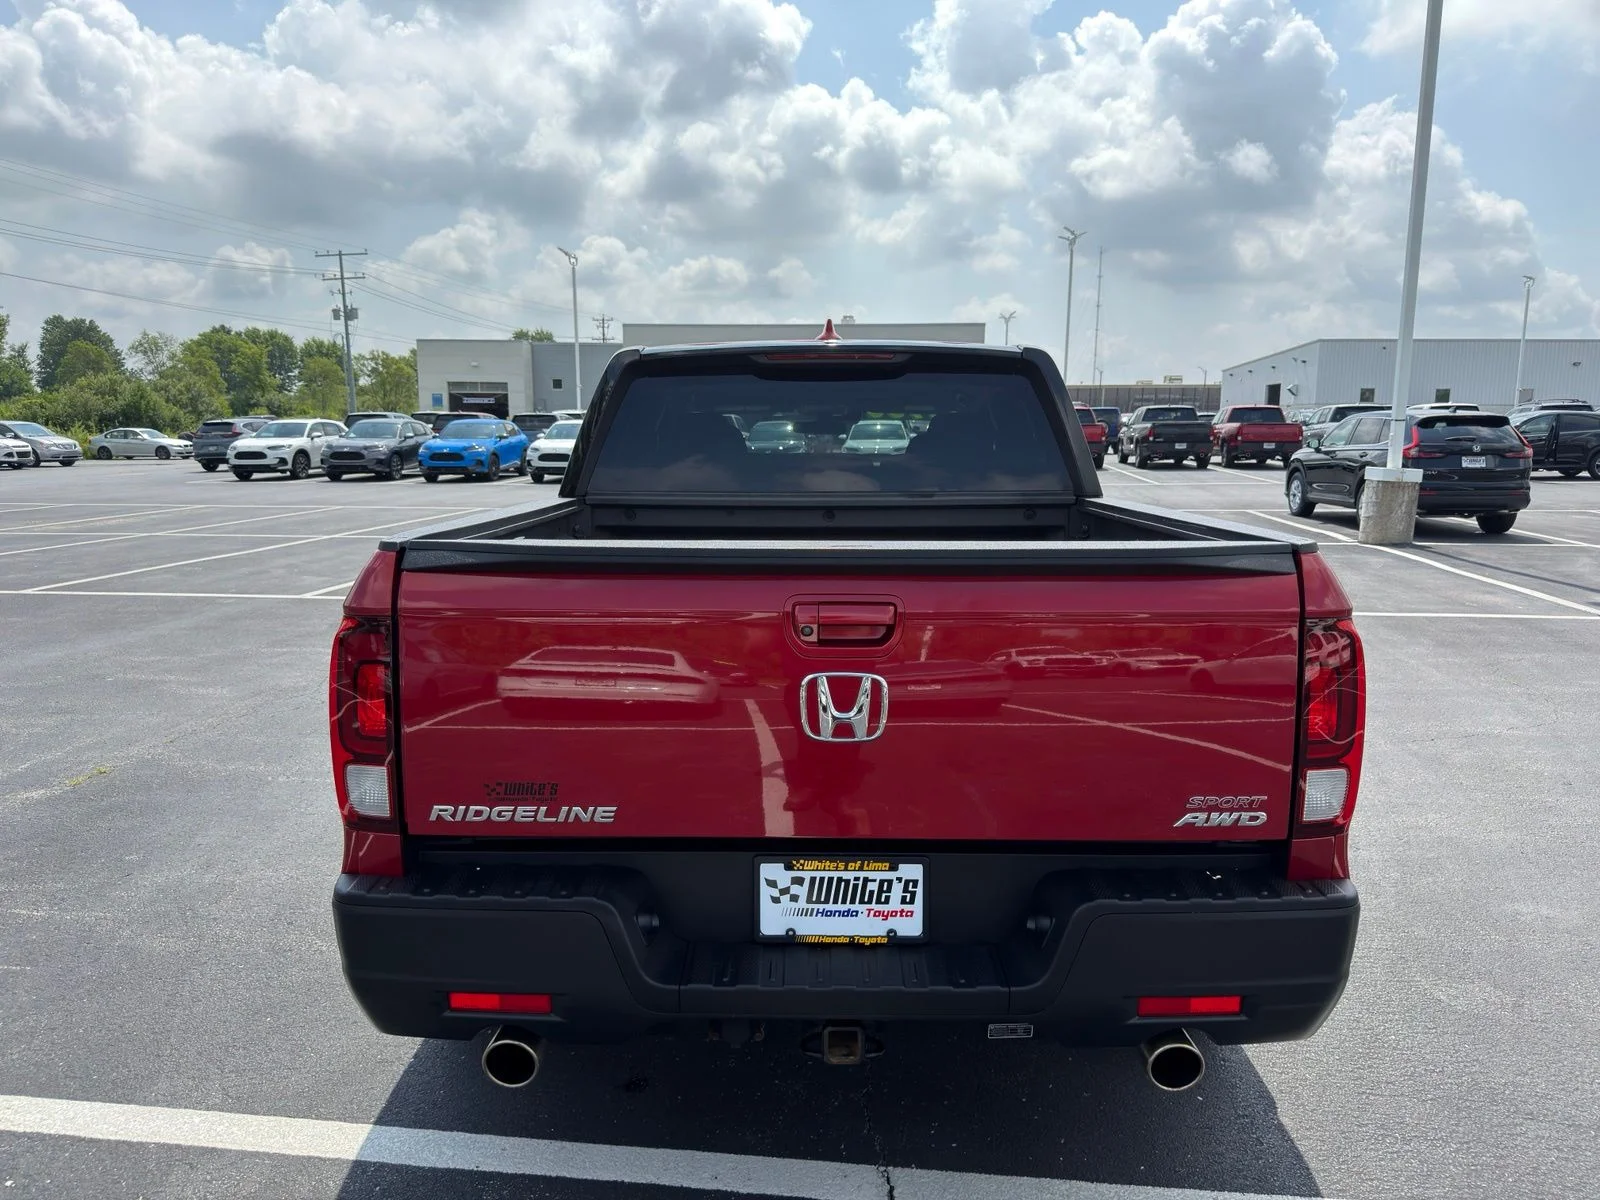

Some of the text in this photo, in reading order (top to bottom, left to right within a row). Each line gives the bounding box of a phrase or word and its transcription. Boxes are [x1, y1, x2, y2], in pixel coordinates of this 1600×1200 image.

[503, 782, 559, 796] White's
[1185, 795, 1268, 808] SPORT
[429, 805, 618, 823] RIDGELINE
[1173, 811, 1268, 827] AWD
[803, 860, 890, 871] White's of Lima
[805, 876, 919, 905] White's
[815, 908, 914, 921] Honda Toyota
[818, 935, 888, 946] Honda Toyota
